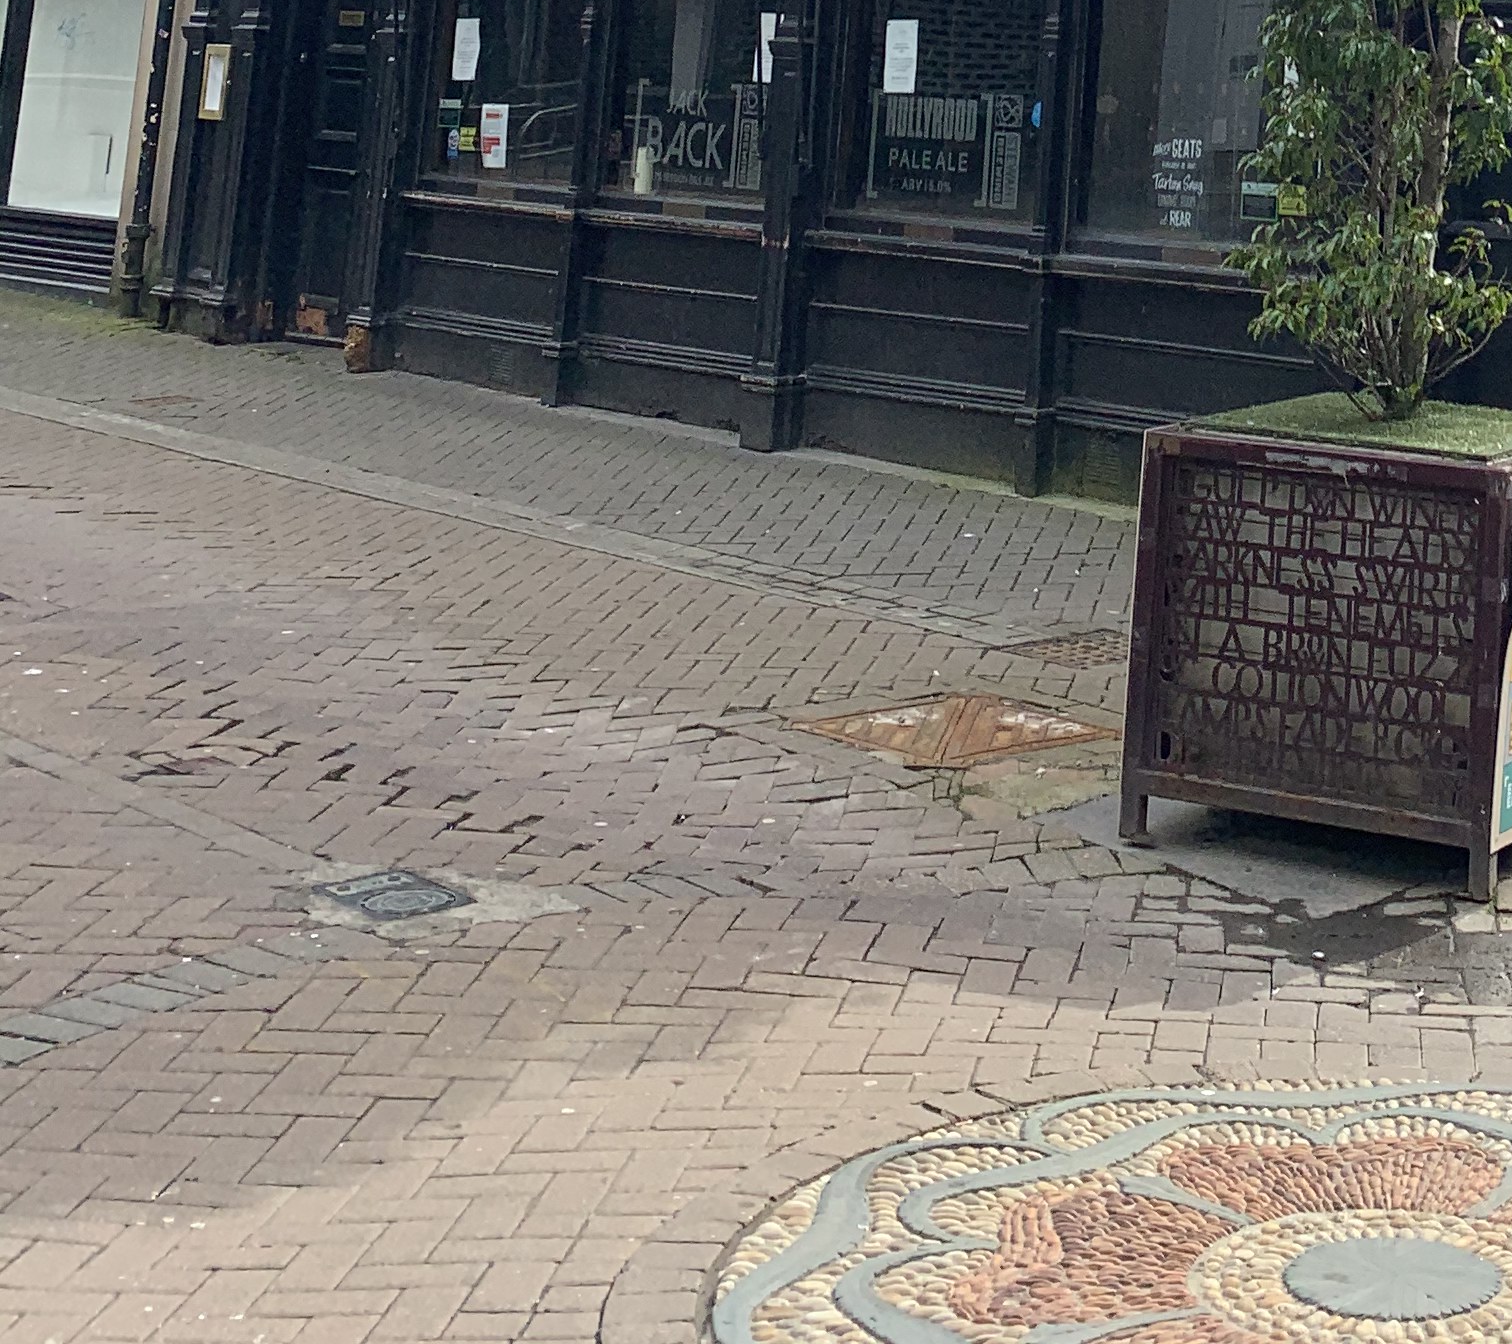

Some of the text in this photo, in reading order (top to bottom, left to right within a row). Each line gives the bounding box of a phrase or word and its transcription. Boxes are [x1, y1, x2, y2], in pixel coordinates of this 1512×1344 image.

[646, 116, 727, 170] BACK
[888, 147, 969, 173] PALE ALE
